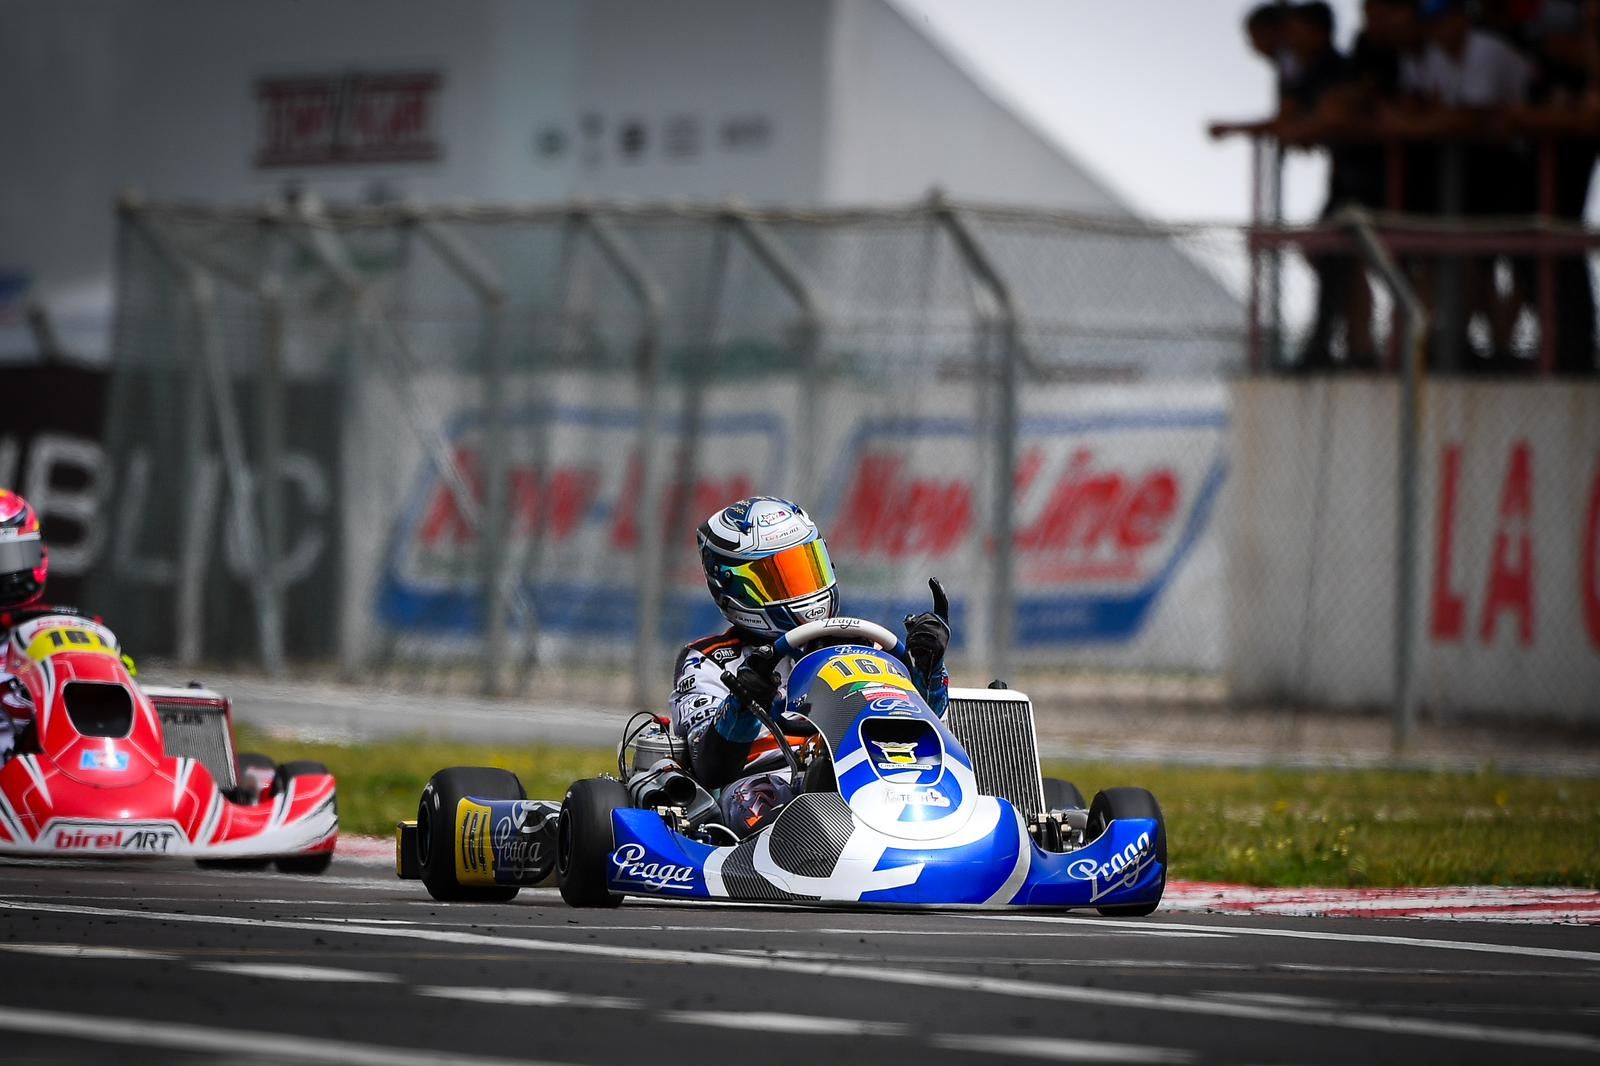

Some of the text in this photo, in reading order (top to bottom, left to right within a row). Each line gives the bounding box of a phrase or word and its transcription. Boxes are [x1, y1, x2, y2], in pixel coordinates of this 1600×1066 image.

[0, 432, 328, 588] BLIC
[1428, 438, 1535, 648] LA
[714, 649, 735, 661] OMP
[832, 646, 876, 658] Praga
[495, 816, 541, 879] Praga
[612, 843, 694, 892] Praga
[1067, 831, 1156, 903] Praga
